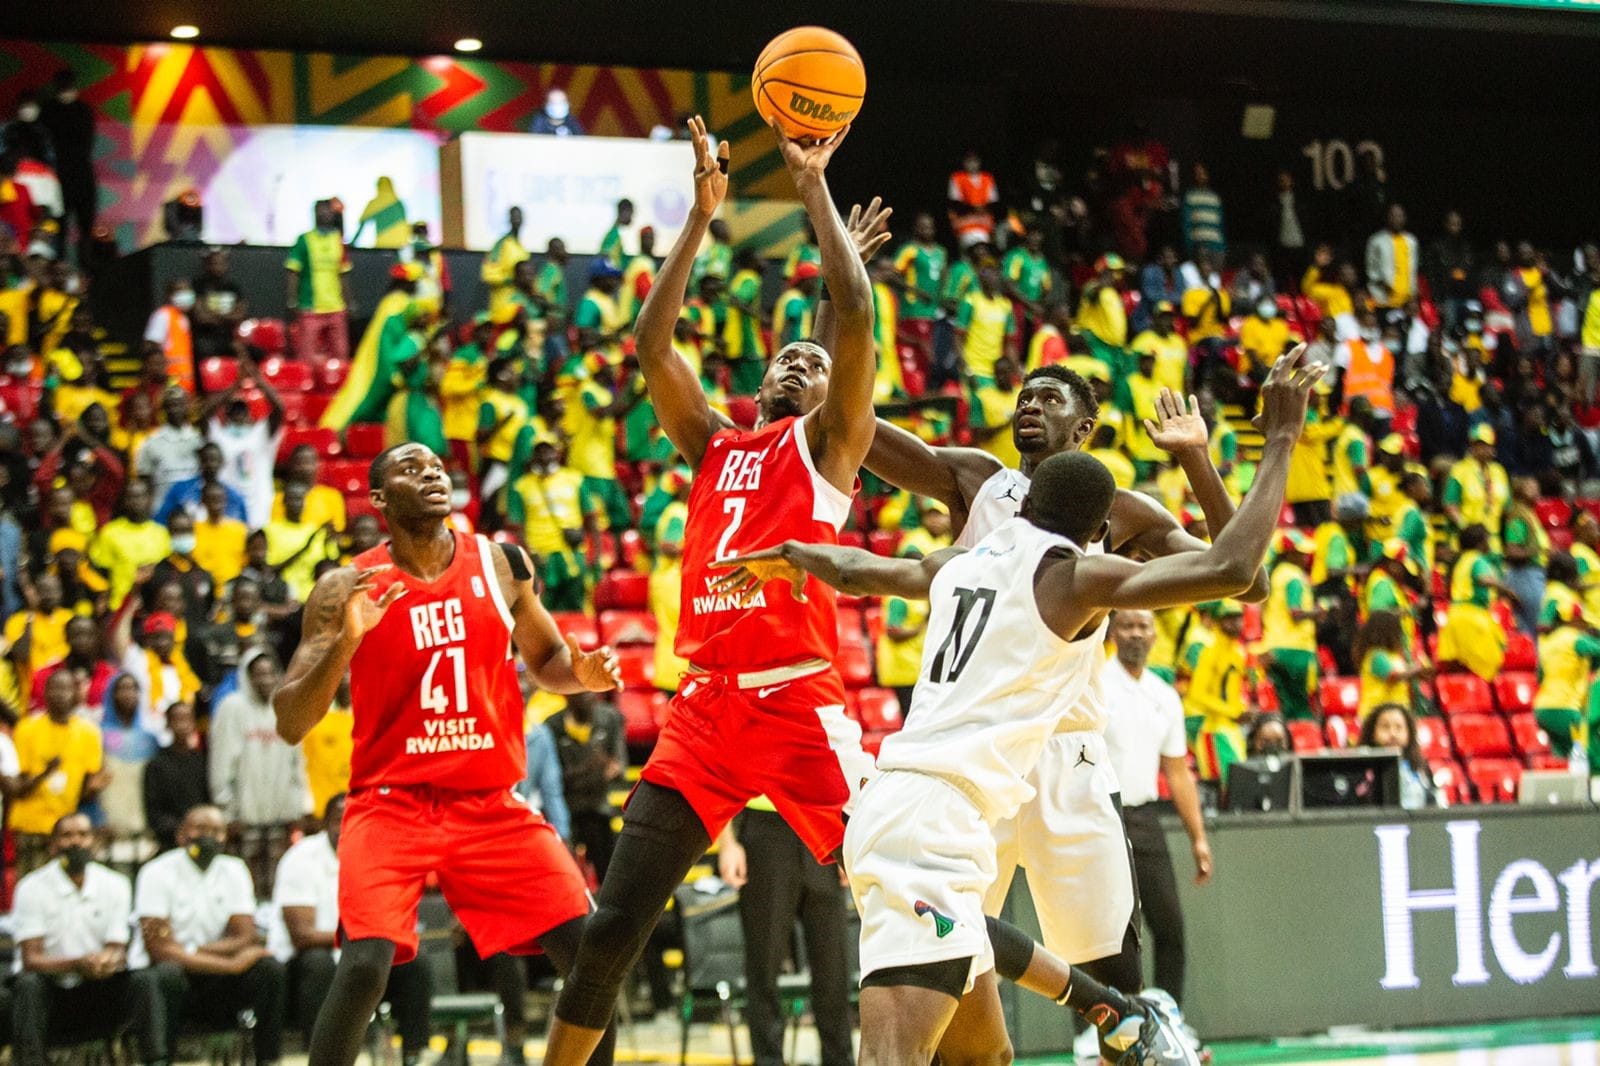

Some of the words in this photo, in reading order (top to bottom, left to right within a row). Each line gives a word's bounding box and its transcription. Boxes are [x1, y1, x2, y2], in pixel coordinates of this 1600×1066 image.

[790, 91, 854, 122] Wilson
[715, 449, 769, 491] REG
[715, 497, 746, 562] 2
[704, 575, 747, 594] VIS
[409, 598, 466, 650] REG
[929, 587, 997, 683] 10
[420, 647, 468, 714] 41
[406, 732, 494, 754] RWANDA
[423, 717, 477, 737] VISIT
